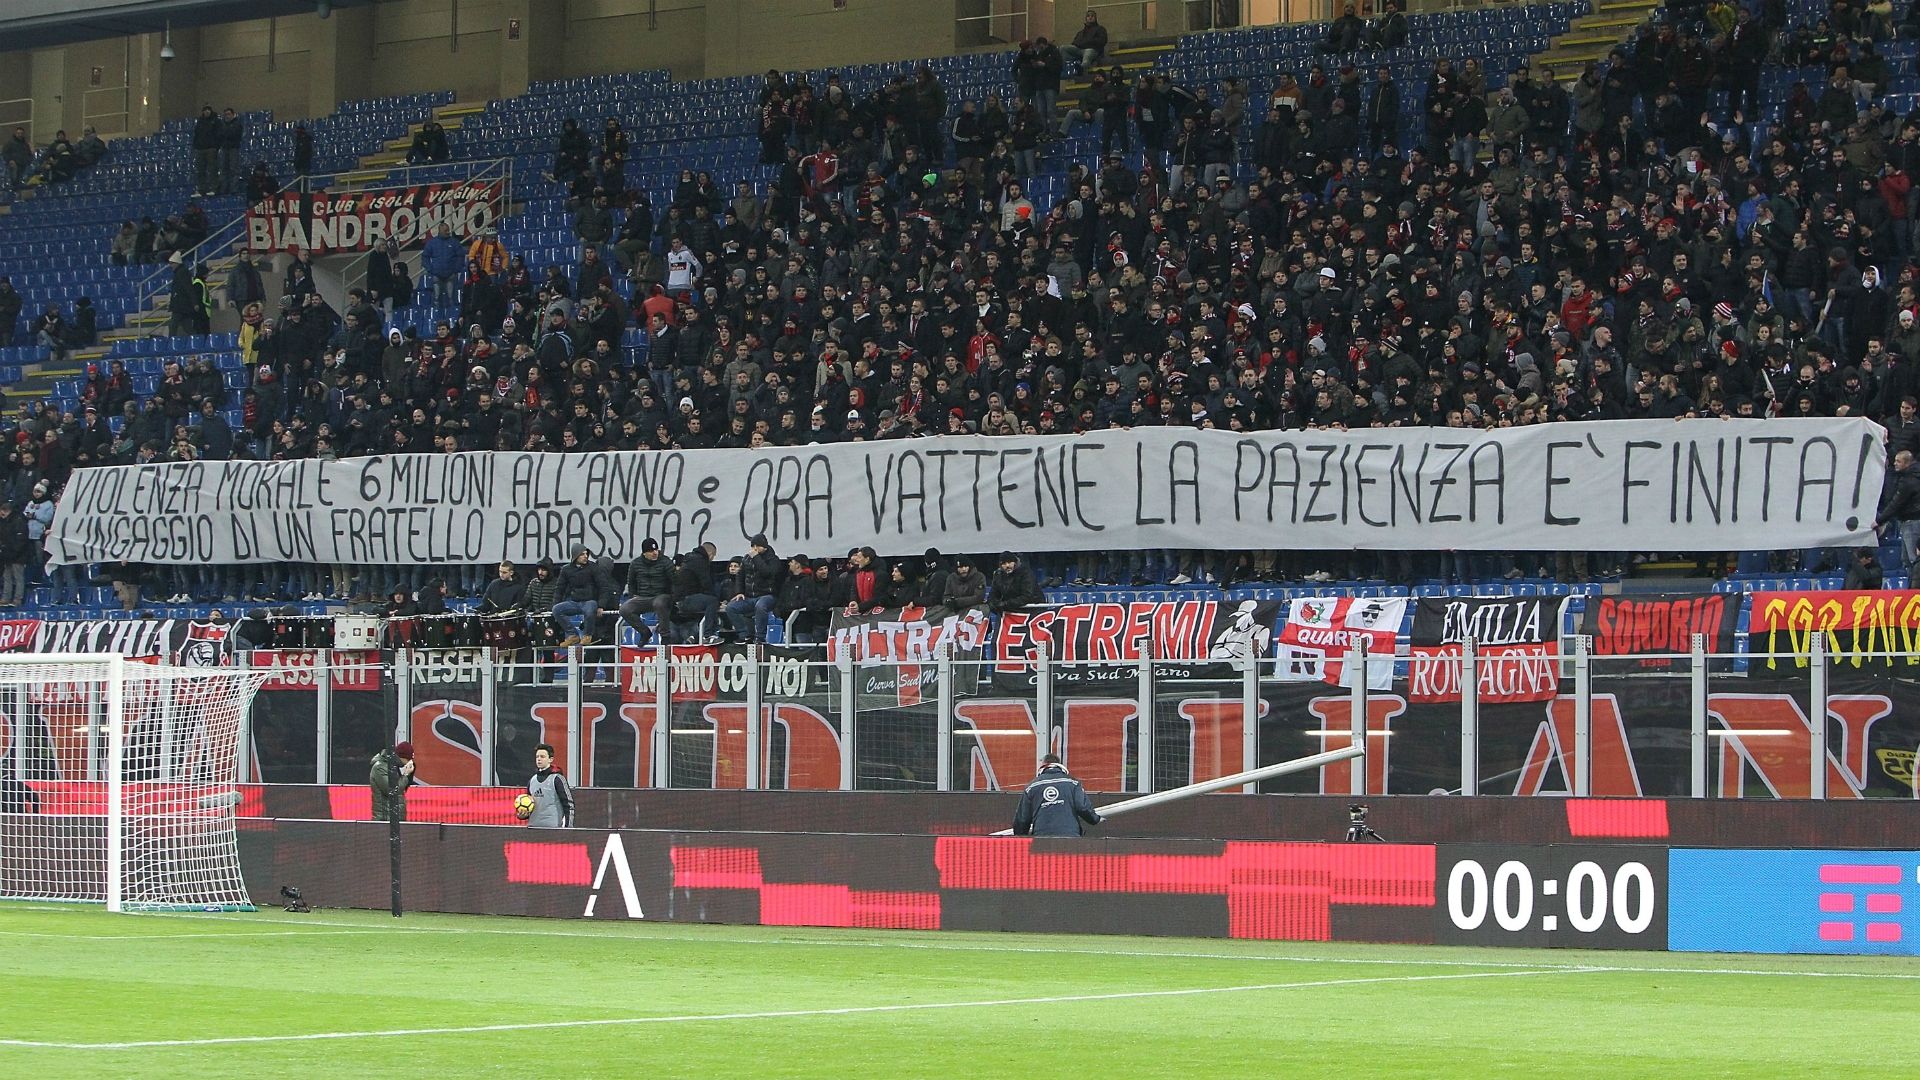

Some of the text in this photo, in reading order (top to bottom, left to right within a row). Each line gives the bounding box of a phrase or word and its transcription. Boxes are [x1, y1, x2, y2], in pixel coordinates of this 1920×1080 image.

[254, 187, 492, 216] MILAN CLUB ISOLA VIRGINIA
[249, 202, 493, 250] BIANDRONNO
[72, 462, 206, 515] VIOLENZA
[216, 459, 333, 511] MORALE
[359, 456, 382, 502] 6
[388, 453, 495, 508] MILIONI
[513, 452, 685, 508] ALL'ANNO
[739, 454, 833, 541] ORA
[865, 443, 1105, 534] VATTENE
[1136, 440, 1201, 525] LA
[1234, 439, 1504, 527] PAZIENZA
[1623, 433, 1874, 532] FINITA!
[59, 515, 214, 562] L'INGAGGIO
[231, 510, 260, 560] DI
[273, 510, 318, 560] UN
[331, 507, 484, 562] FRATELLO
[34, 618, 176, 658] VECCHIA
[835, 608, 984, 669] ULTRAS
[995, 601, 1218, 673] ESTREMI
[1297, 629, 1374, 648] QUARTO
[1440, 600, 1542, 645] EMILIA
[1595, 595, 1725, 655] SONDRIO
[395, 649, 517, 684] RESENTI
[629, 653, 809, 697] ANONIO CO NOI
[1028, 667, 1190, 685] Cva Sud Mano
[1447, 859, 1656, 934] 00:00
